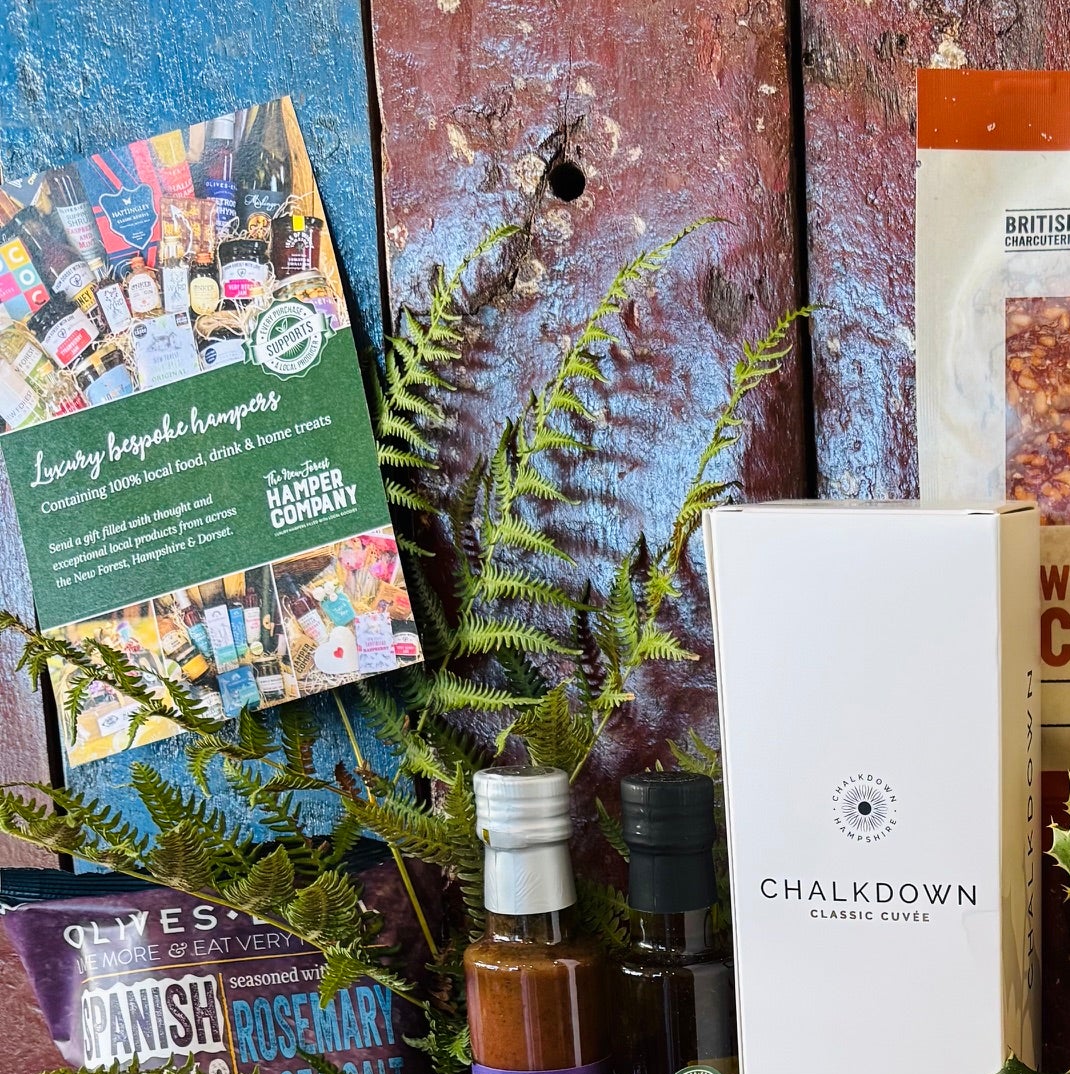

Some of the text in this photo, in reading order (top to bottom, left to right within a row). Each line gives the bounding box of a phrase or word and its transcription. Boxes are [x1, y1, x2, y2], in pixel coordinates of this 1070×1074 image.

[260, 302, 304, 335] EVERY PURCHASE
[266, 321, 314, 357] SUPPORTS
[31, 391, 281, 488] Luxury bespoke hampers
[41, 415, 332, 514] Containing 100% local food, drink & home treats
[266, 468, 344, 509] HAMPER
[270, 484, 357, 529] COMPANY
[56, 528, 234, 588] the New Forest, Hampshire & Dorset.
[831, 773, 898, 803] CHALKDOWN
[832, 817, 898, 844] HAMPSHIRE
[760, 877, 977, 907] CHALKDOWN
[810, 909, 931, 923] CLASSIC CUVÉE
[102, 932, 292, 968] MORE EAT VERY
[229, 971, 299, 990] seasoned
[82, 979, 222, 1064] SPANISH
[233, 985, 398, 1064] ROSEMARY
